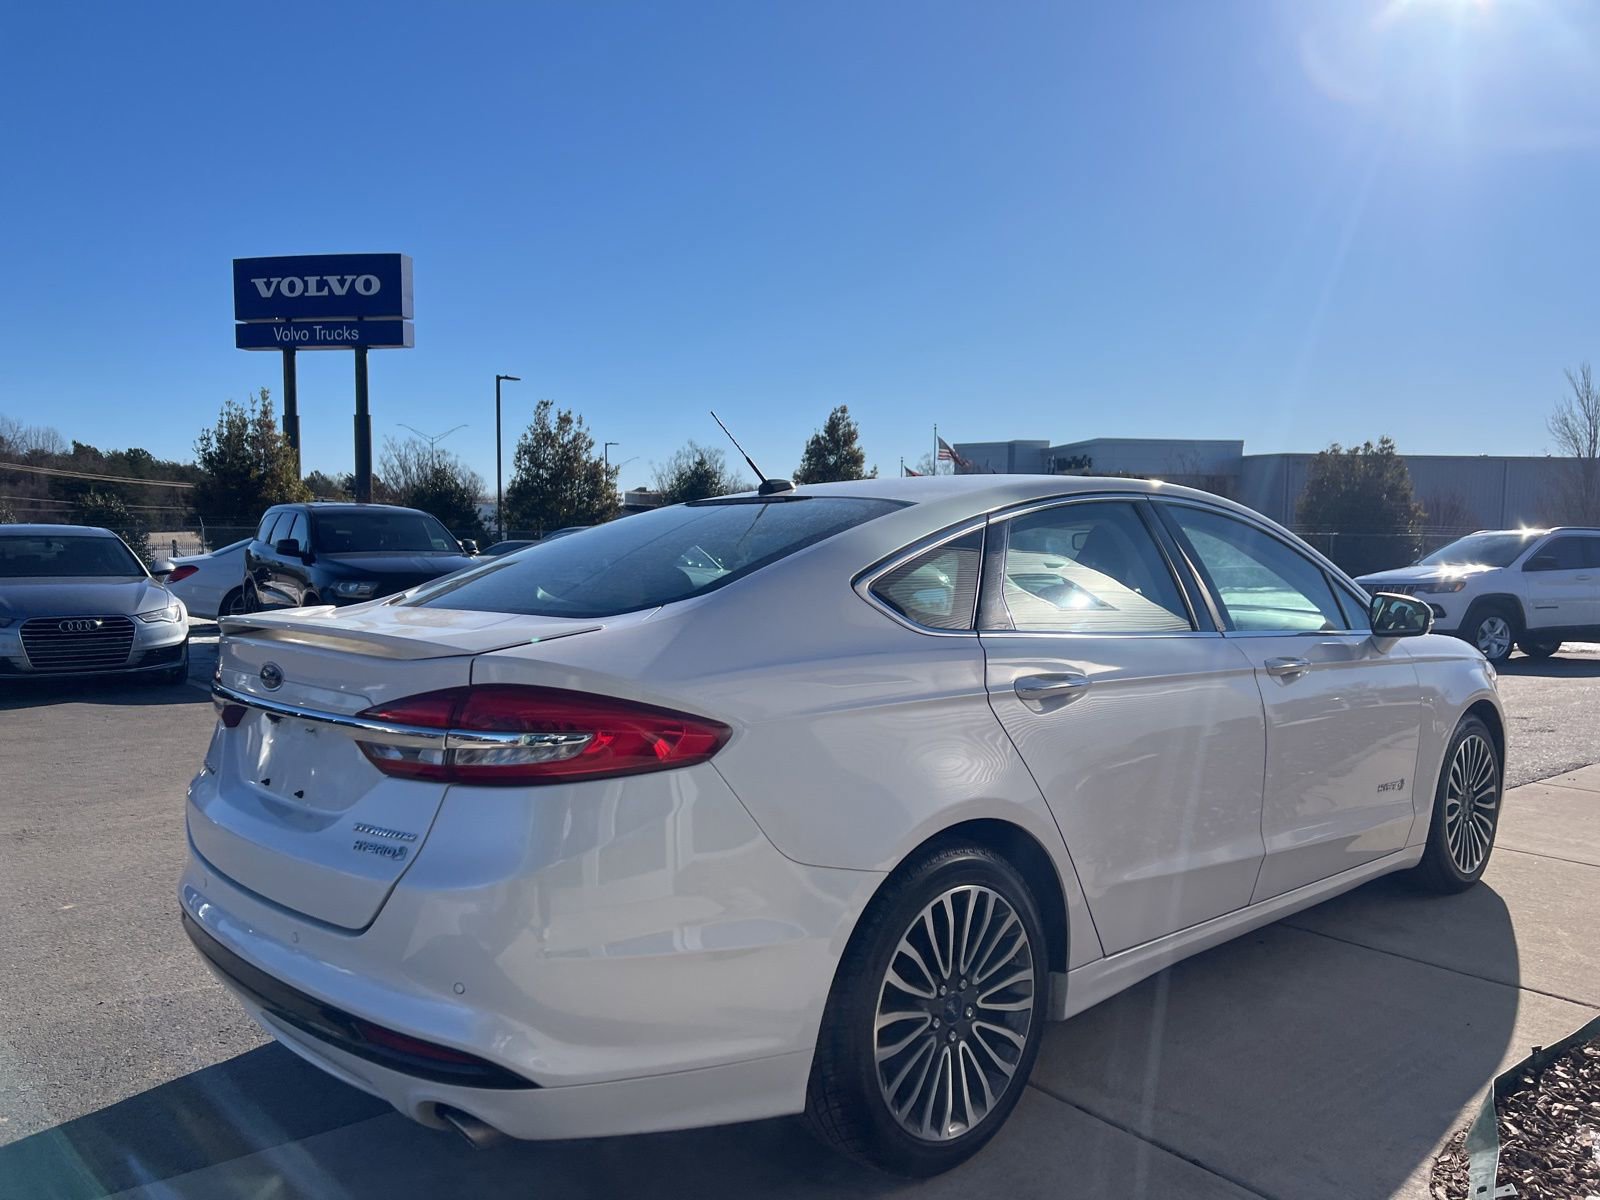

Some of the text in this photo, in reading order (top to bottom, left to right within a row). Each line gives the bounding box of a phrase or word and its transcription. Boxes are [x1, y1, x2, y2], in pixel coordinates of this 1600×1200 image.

[251, 274, 381, 298] VOLVO
[273, 322, 359, 341] Volvo Trucks
